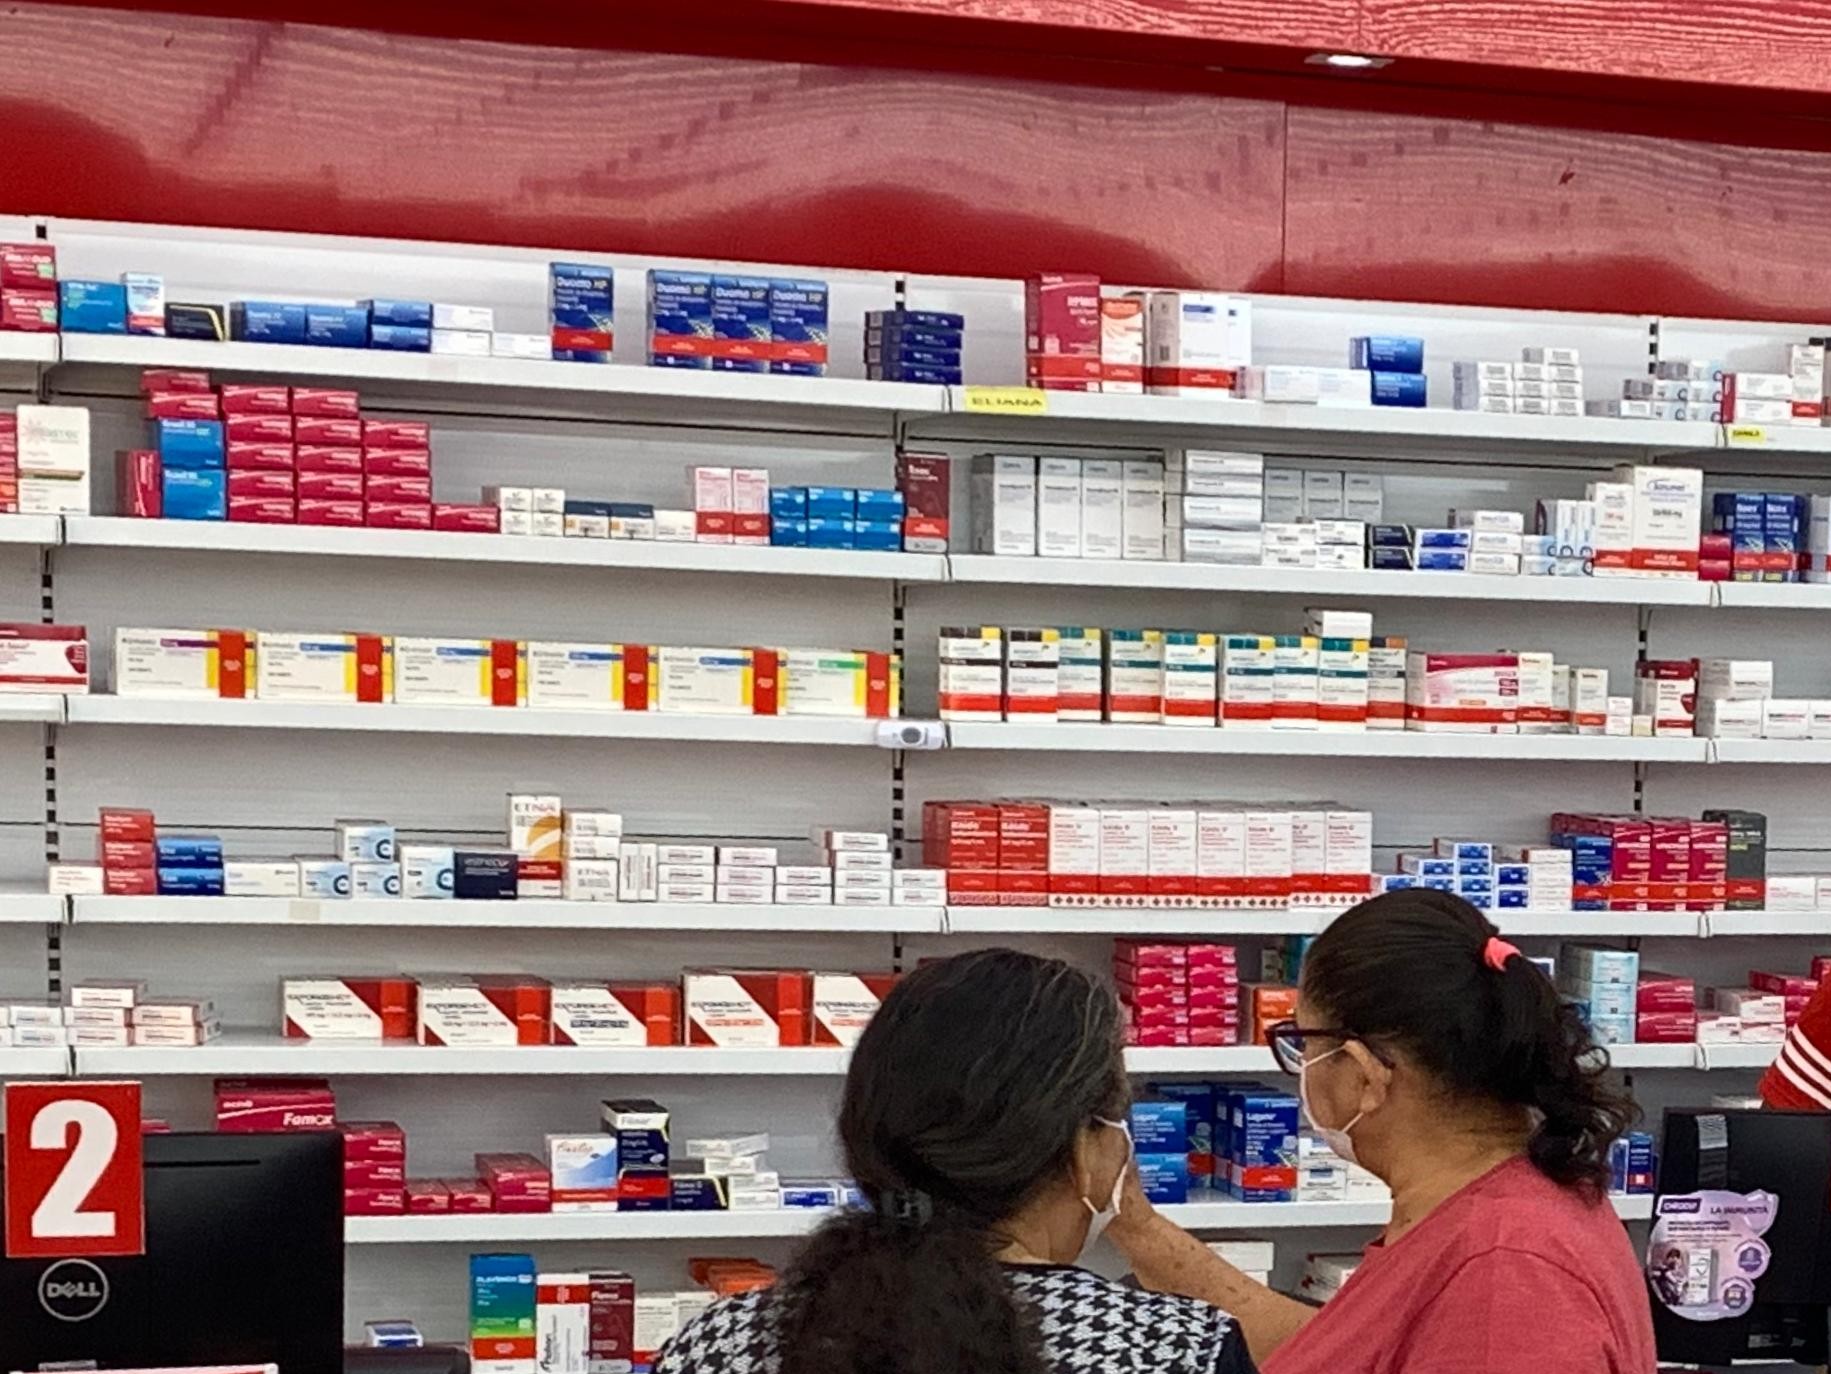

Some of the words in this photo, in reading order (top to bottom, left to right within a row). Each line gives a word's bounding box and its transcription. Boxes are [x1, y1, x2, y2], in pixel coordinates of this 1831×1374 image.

[283, 1112, 334, 1126] Famox
[29, 1098, 118, 1238] 2
[46, 1281, 101, 1299] DELL
